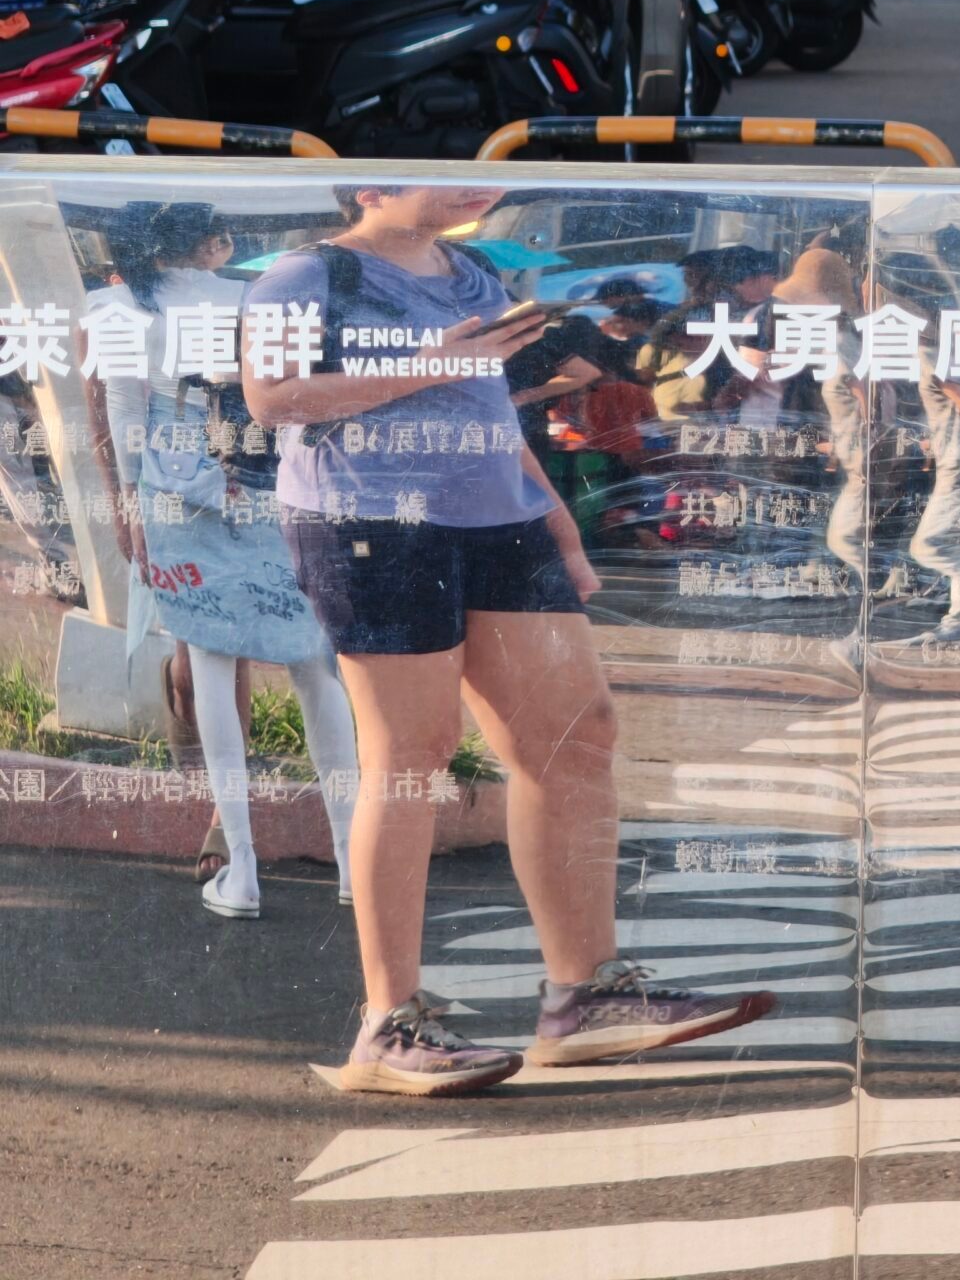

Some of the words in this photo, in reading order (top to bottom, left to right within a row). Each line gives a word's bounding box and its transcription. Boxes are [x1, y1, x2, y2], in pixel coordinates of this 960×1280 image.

[0, 301, 323, 380] 萊倉庫群
[342, 328, 443, 348] PENGLAI
[341, 357, 504, 378] WAREHOUSES
